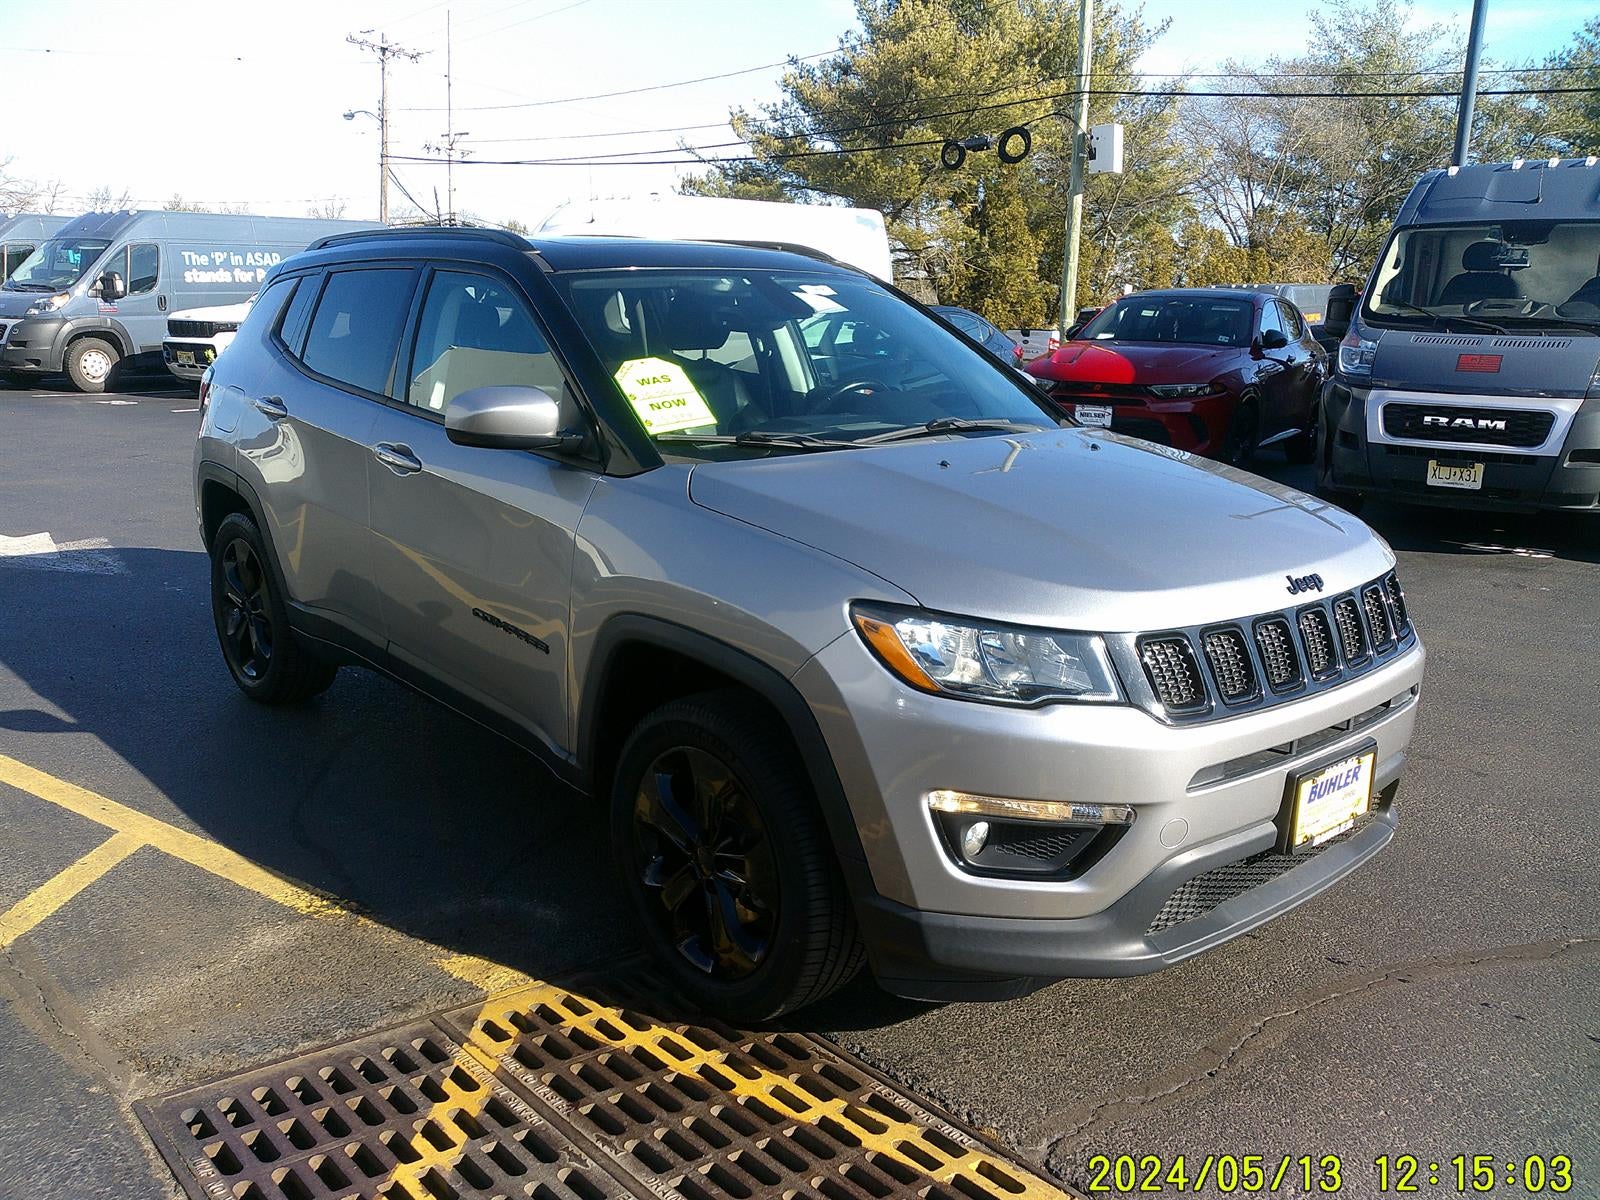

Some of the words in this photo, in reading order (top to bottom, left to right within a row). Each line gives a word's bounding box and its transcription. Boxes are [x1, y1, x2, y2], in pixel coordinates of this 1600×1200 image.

[181, 251, 209, 265] The
[230, 252, 243, 266] in
[246, 252, 280, 267] ASAP
[184, 268, 232, 283] stands
[233, 268, 254, 283] for
[636, 374, 672, 386] WAS
[649, 398, 687, 411] NOW
[1079, 411, 1106, 419] NIELSEN
[1423, 416, 1507, 431] RAM
[1285, 572, 1325, 596] Jeep
[1307, 765, 1362, 805] BUHLER
